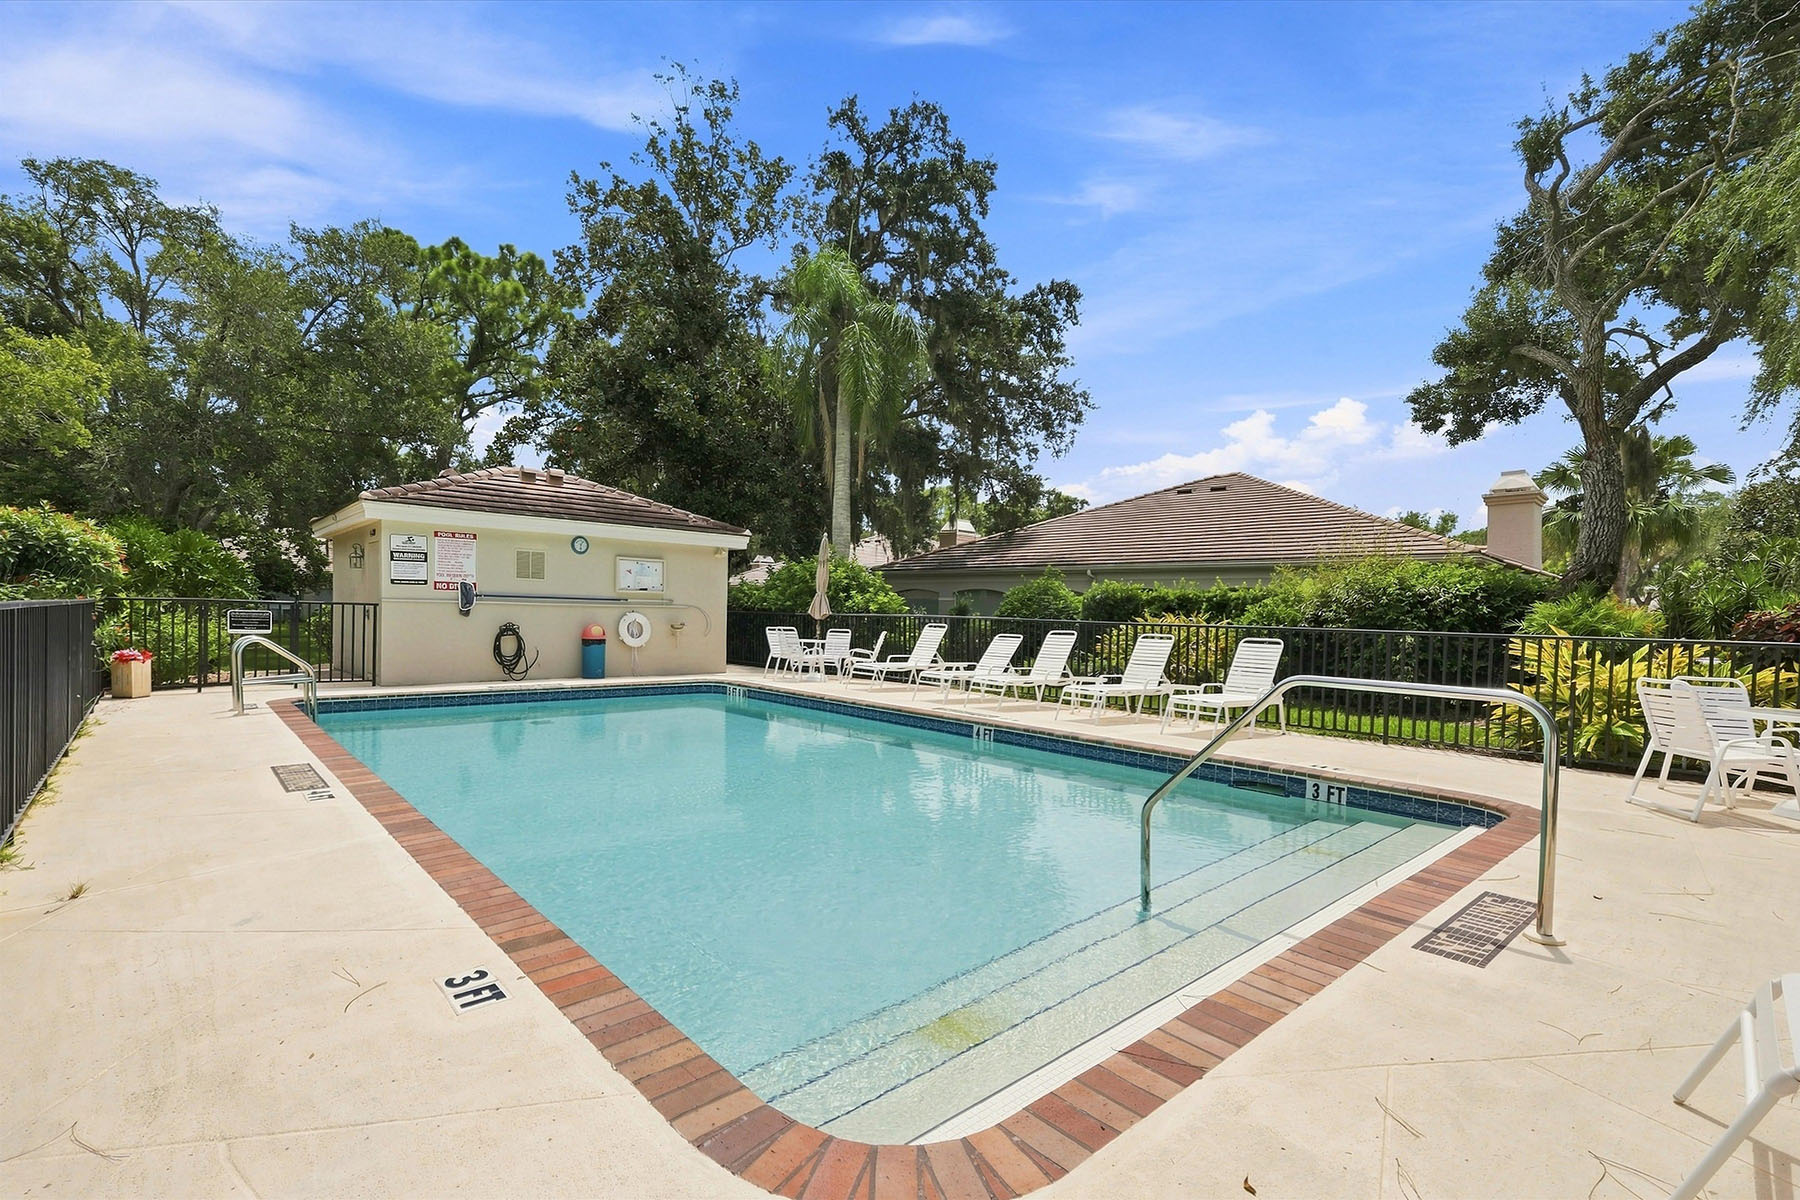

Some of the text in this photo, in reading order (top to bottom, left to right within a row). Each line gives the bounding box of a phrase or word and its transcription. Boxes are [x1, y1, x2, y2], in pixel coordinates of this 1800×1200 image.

[975, 726, 993, 742] 4 FT
[1312, 783, 1346, 803] 3 FT
[444, 969, 507, 1009] 3 FT
